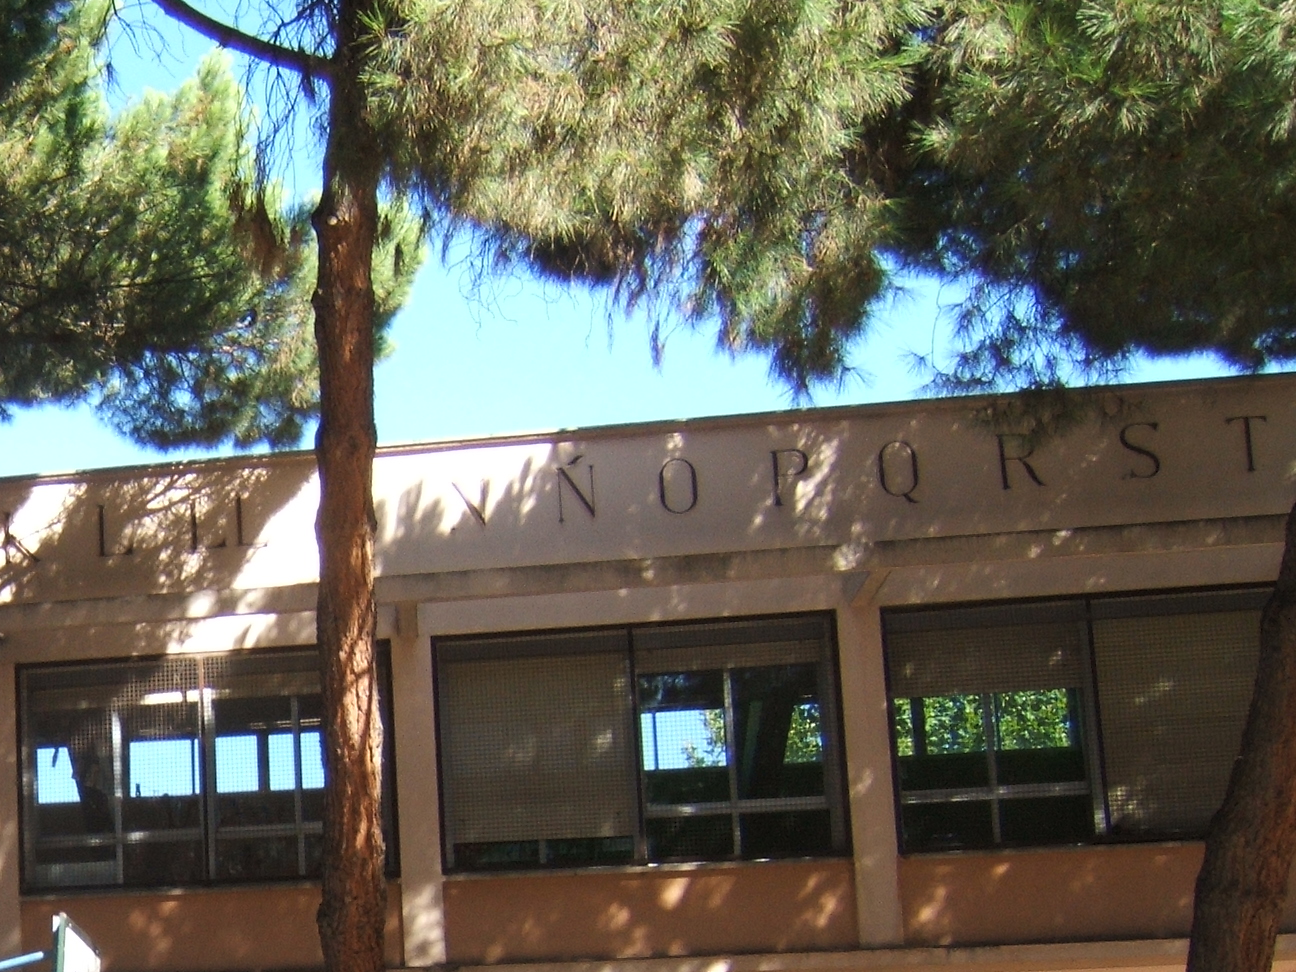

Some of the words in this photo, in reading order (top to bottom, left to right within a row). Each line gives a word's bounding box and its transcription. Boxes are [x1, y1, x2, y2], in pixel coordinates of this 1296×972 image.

[5, 512, 40, 564] K
[97, 504, 132, 557] L
[556, 455, 596, 523] Ñ
[658, 458, 698, 514] O
[769, 449, 808, 506] P
[878, 440, 919, 504] Q
[996, 434, 1046, 489] R
[1119, 422, 1160, 480] S
[1224, 415, 1267, 472] T
